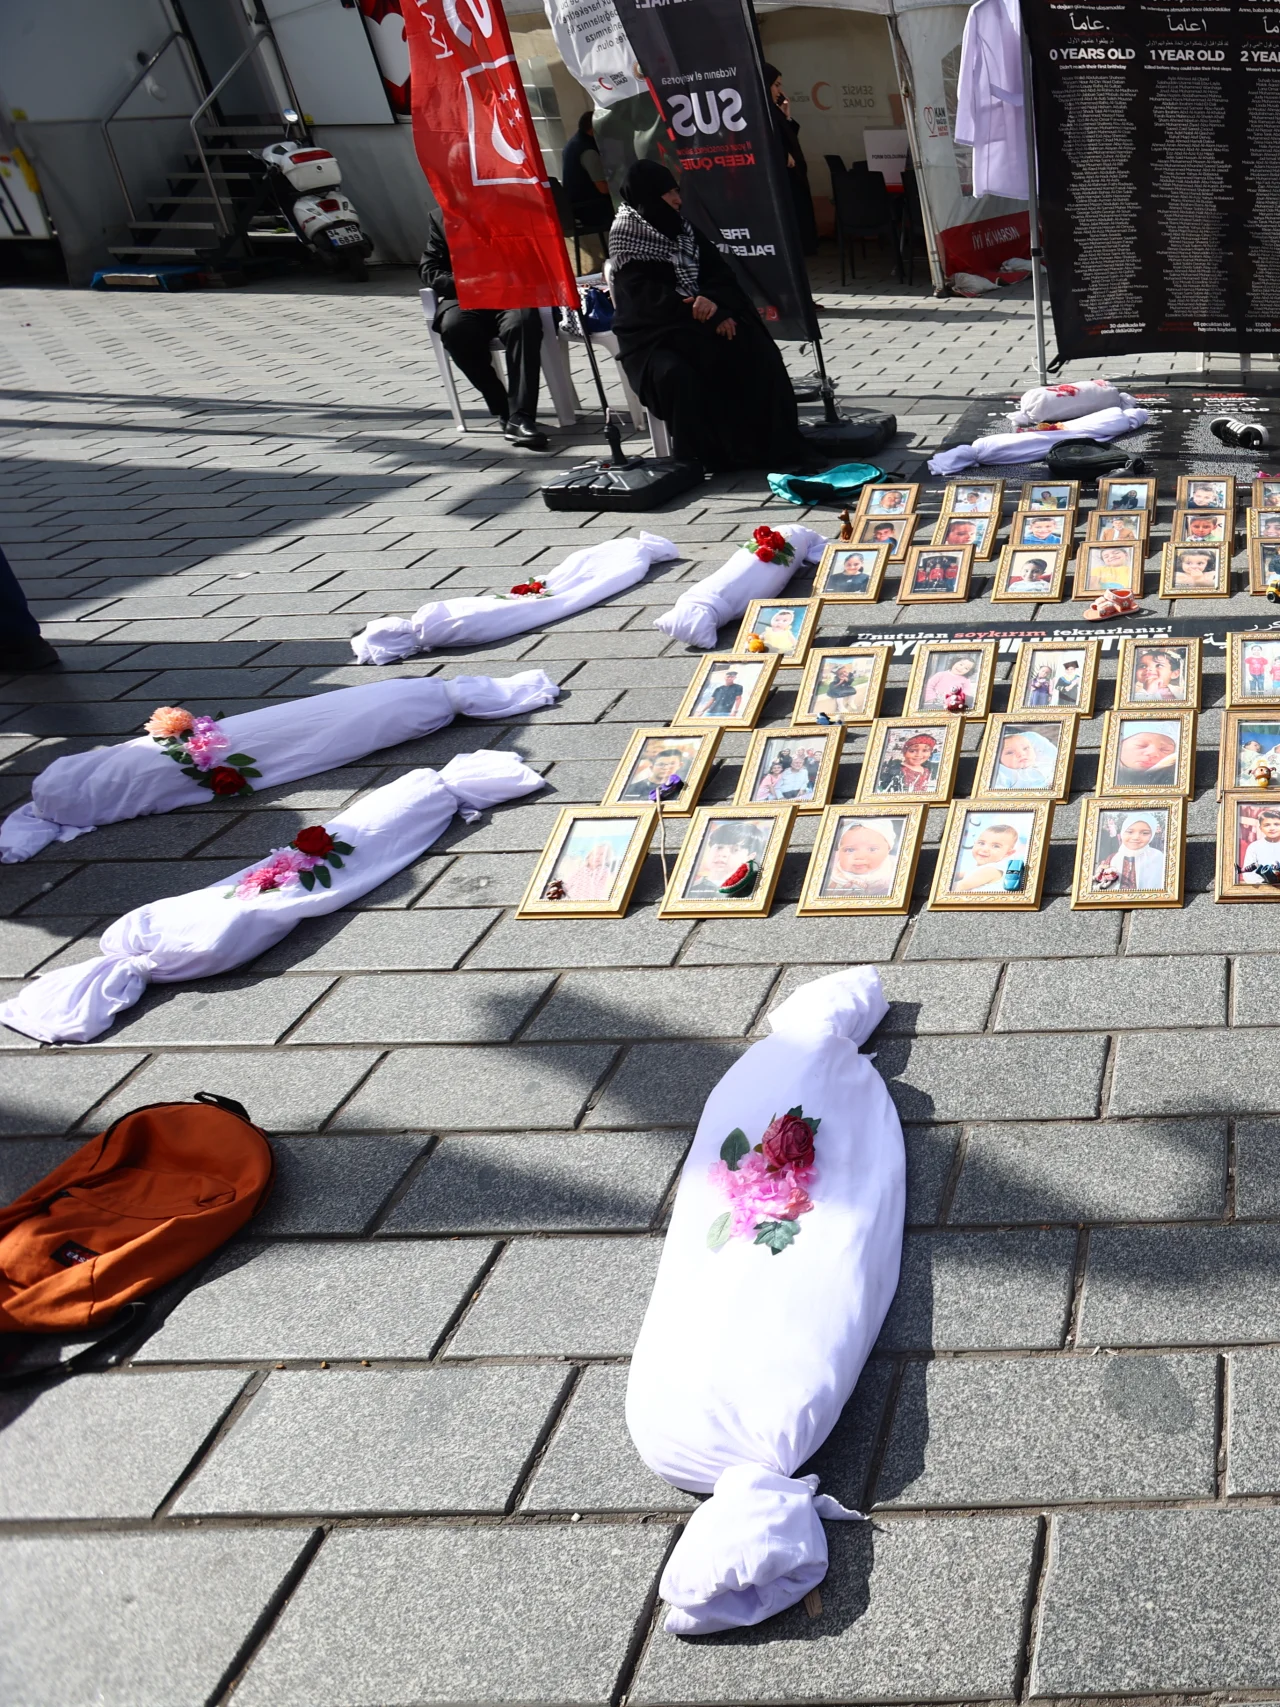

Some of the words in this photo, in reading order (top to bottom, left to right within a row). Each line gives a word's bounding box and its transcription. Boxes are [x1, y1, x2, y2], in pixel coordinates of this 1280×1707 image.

[1049, 49, 1058, 61] 0
[1060, 48, 1105, 60] YEARS
[1107, 48, 1136, 60] OLD
[1150, 50, 1156, 60] 1
[1158, 50, 1195, 61] YEAR
[1197, 50, 1225, 61] OLD
[1240, 51, 1249, 62] 2
[339, 234, 360, 244] 6839
[857, 632, 949, 640] Unutulan
[953, 631, 1047, 640] soykırım
[1053, 625, 1173, 636] tekrarlanır!
